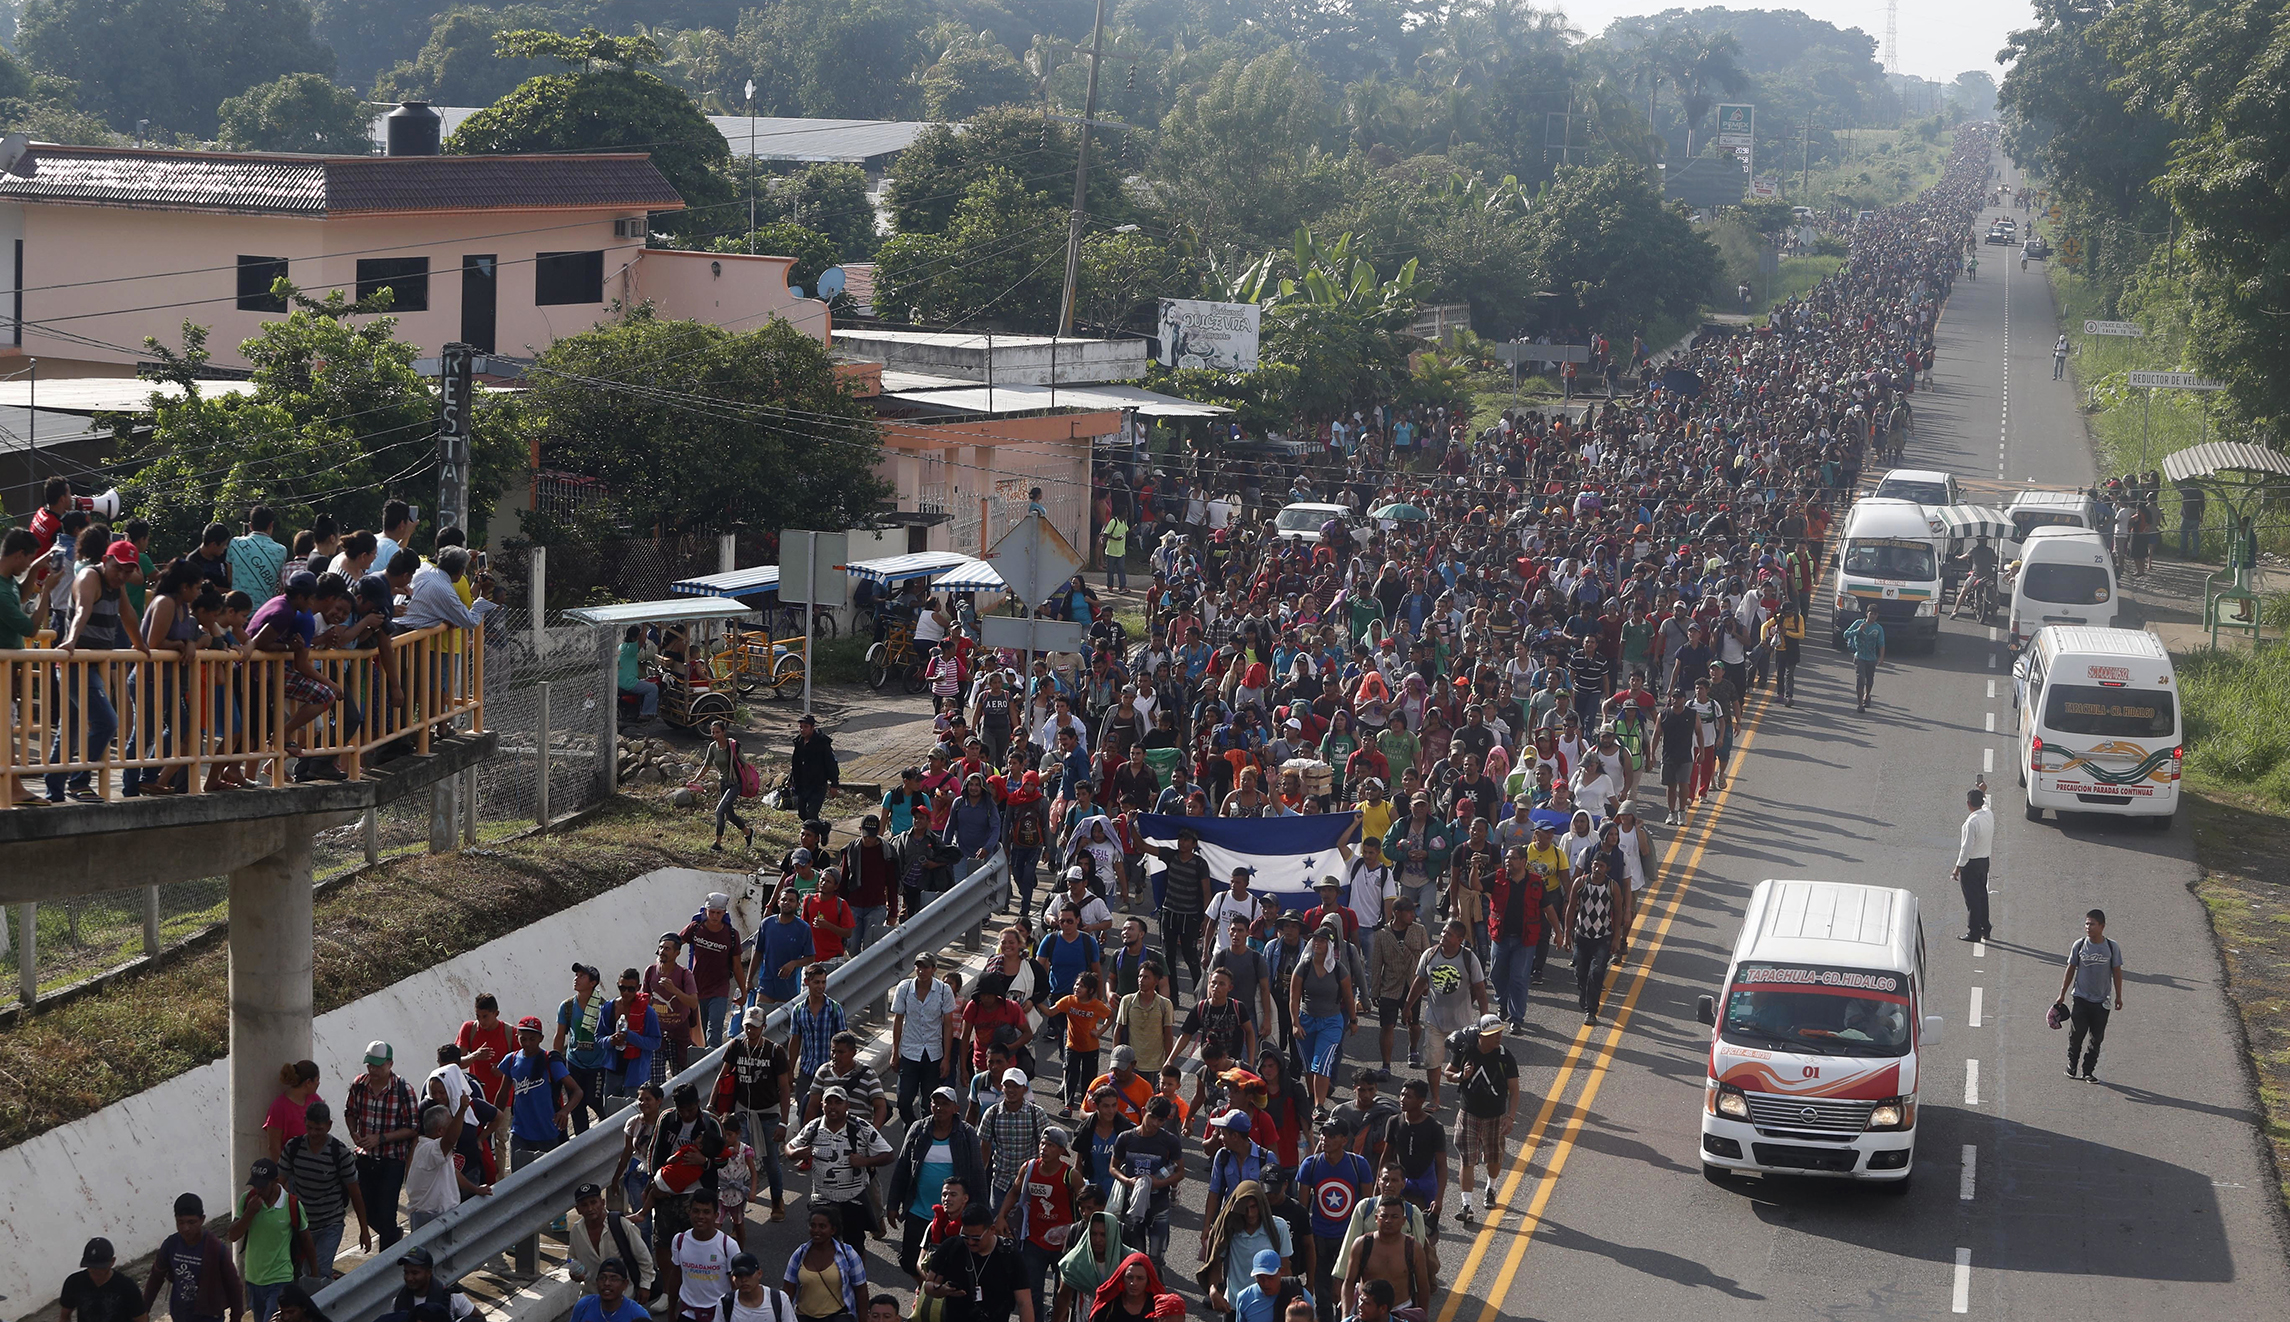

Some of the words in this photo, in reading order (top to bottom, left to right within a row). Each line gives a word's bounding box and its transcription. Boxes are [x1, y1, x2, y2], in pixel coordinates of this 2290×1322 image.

[1722, 121, 1749, 131] PEMEX
[1223, 317, 1252, 332] VITA
[2132, 373, 2169, 385] REDUCTOR
[2171, 375, 2180, 385] DE
[2094, 555, 2103, 563] 25
[1886, 589, 1894, 597] 07
[2158, 676, 2169, 685] 24
[986, 700, 1008, 708] AERO
[2064, 702, 2106, 716] TAPACHULA
[2123, 706, 2156, 719] HIDALGO
[2056, 783, 2092, 793] PRECAUCION
[2093, 785, 2120, 795] PARADAS
[2121, 787, 2153, 797] CONTINUAS
[1802, 1065, 1820, 1079] 01
[682, 1261, 720, 1270] CIUDADANOS
[688, 1272, 719, 1281] UNIDOS
